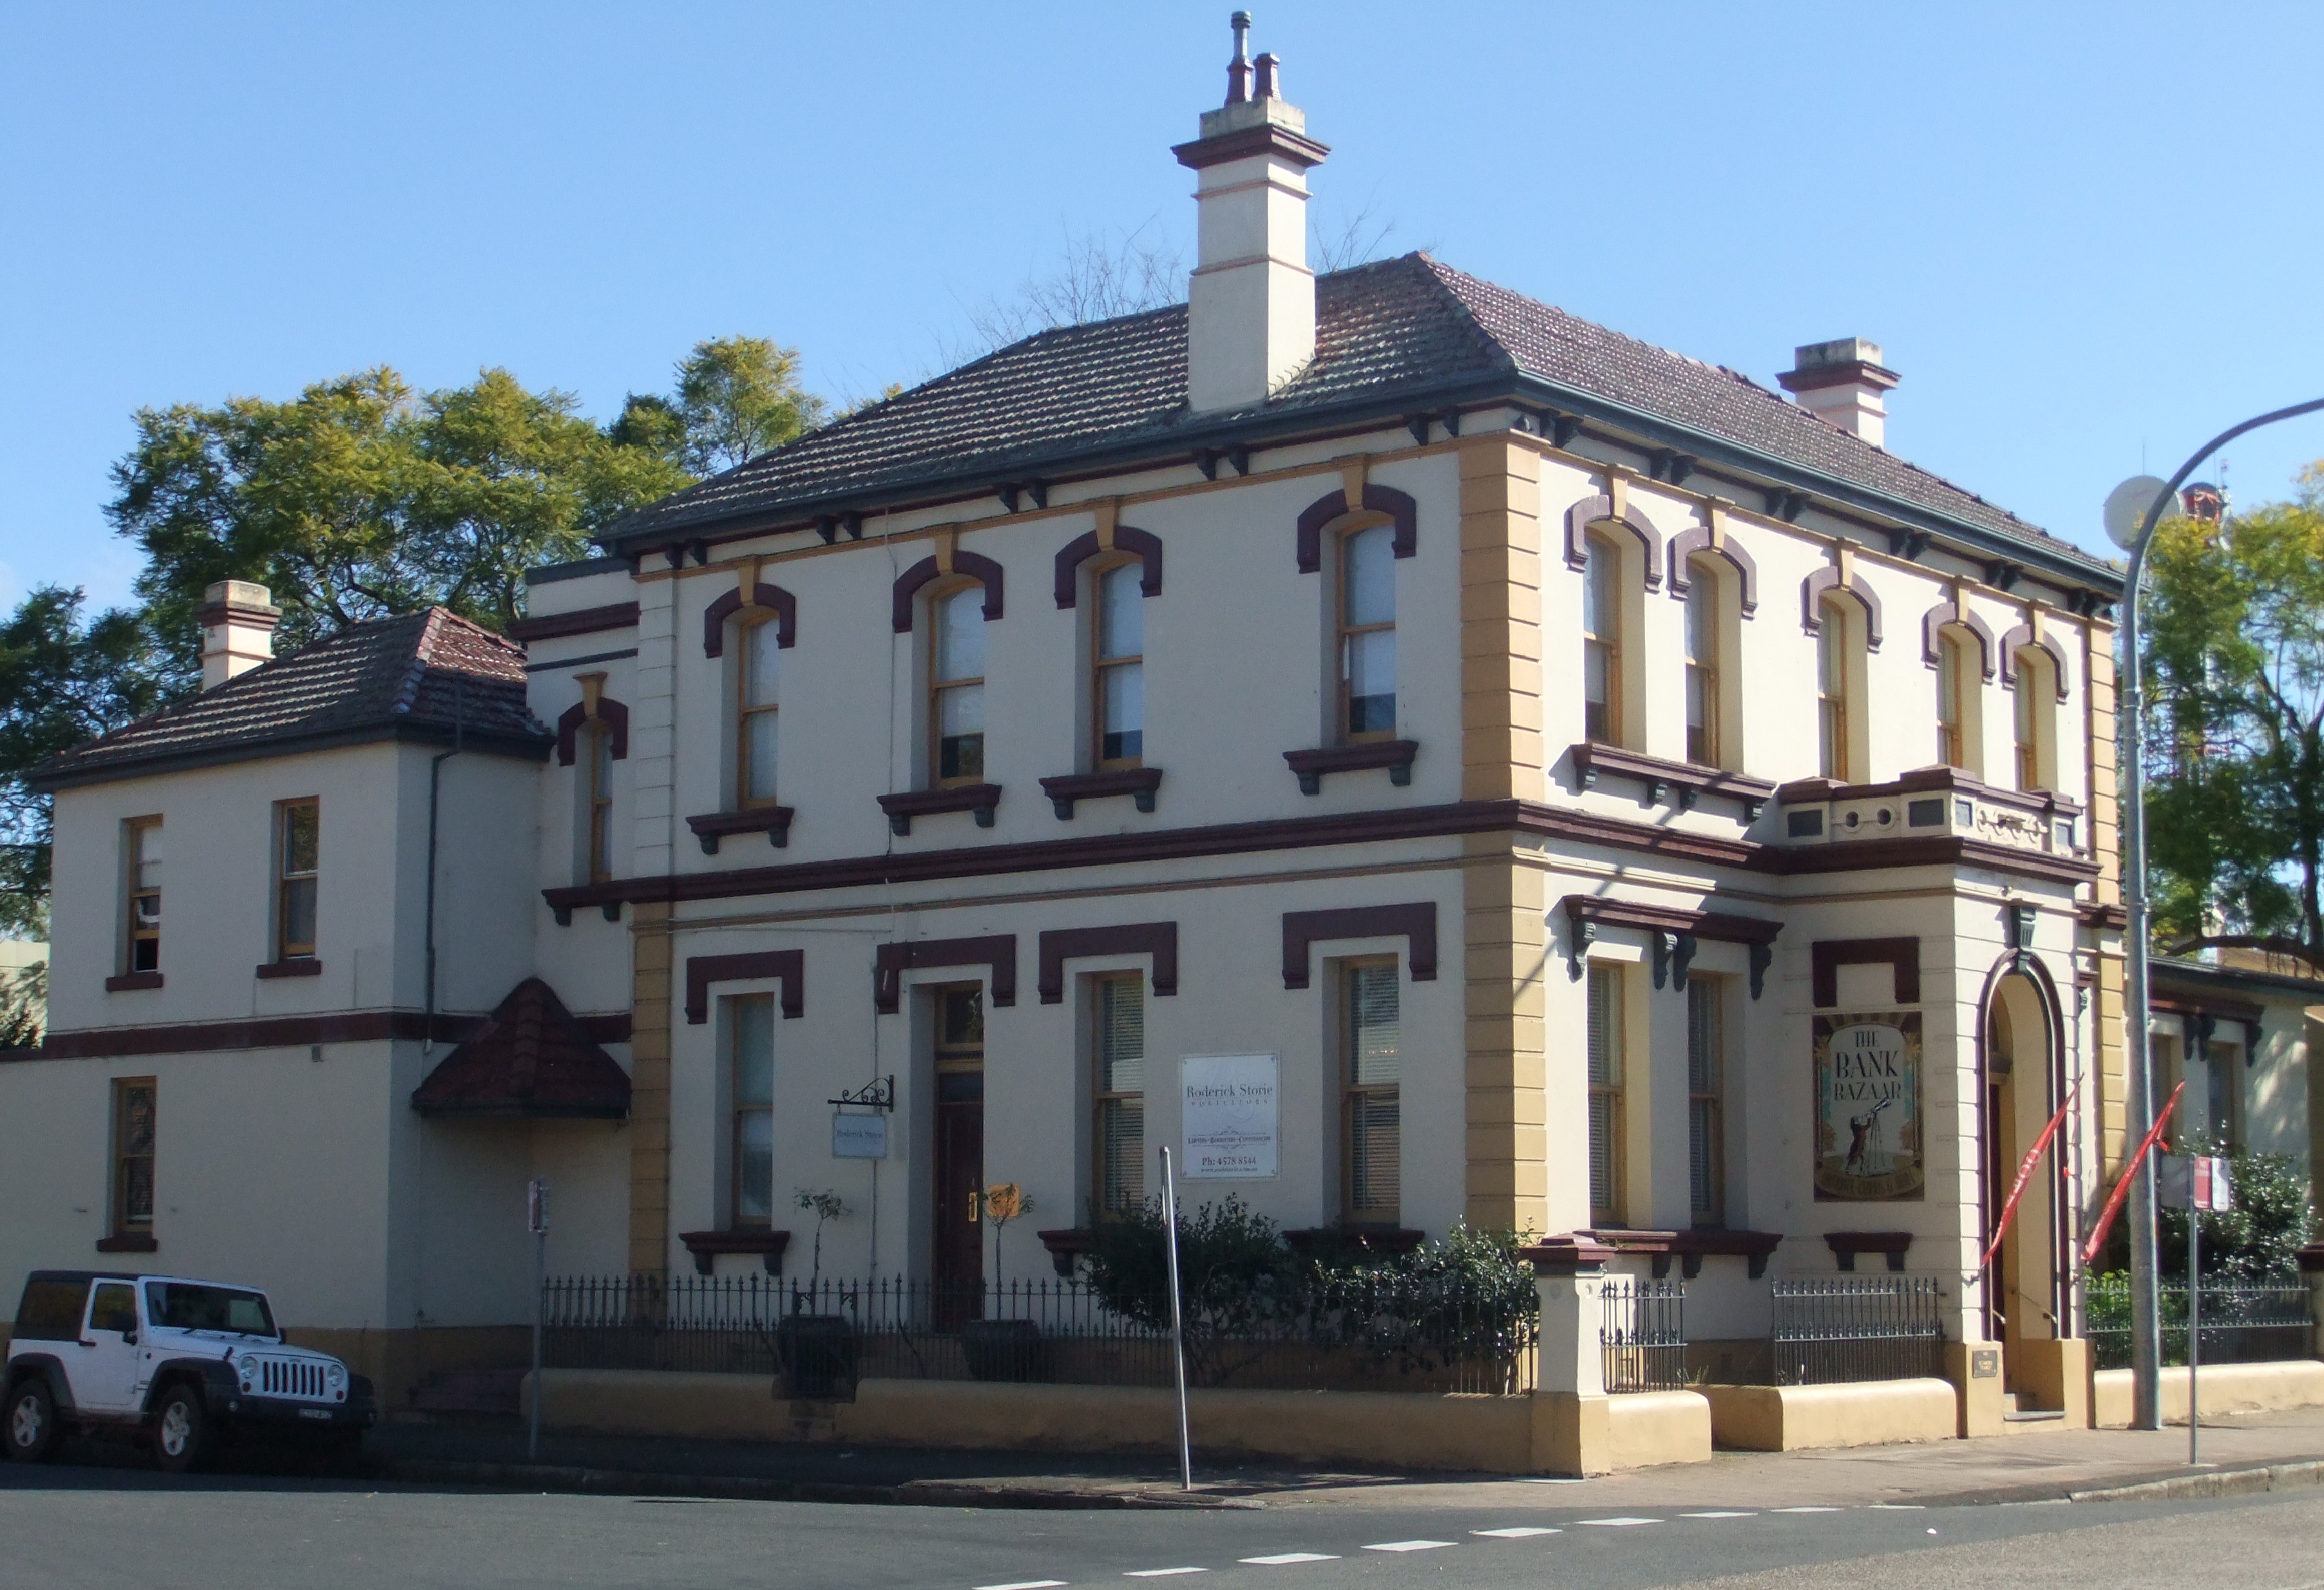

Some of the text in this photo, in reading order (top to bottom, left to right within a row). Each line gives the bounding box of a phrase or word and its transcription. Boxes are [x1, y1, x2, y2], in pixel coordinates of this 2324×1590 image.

[1853, 1030, 1880, 1048] THE
[1835, 1051, 1900, 1078] BANK
[1186, 1083, 1273, 1098] Roderick Storie
[1833, 1080, 1901, 1101] BAZAAR
[1202, 1156, 1256, 1165] Ph: 4578 8544
